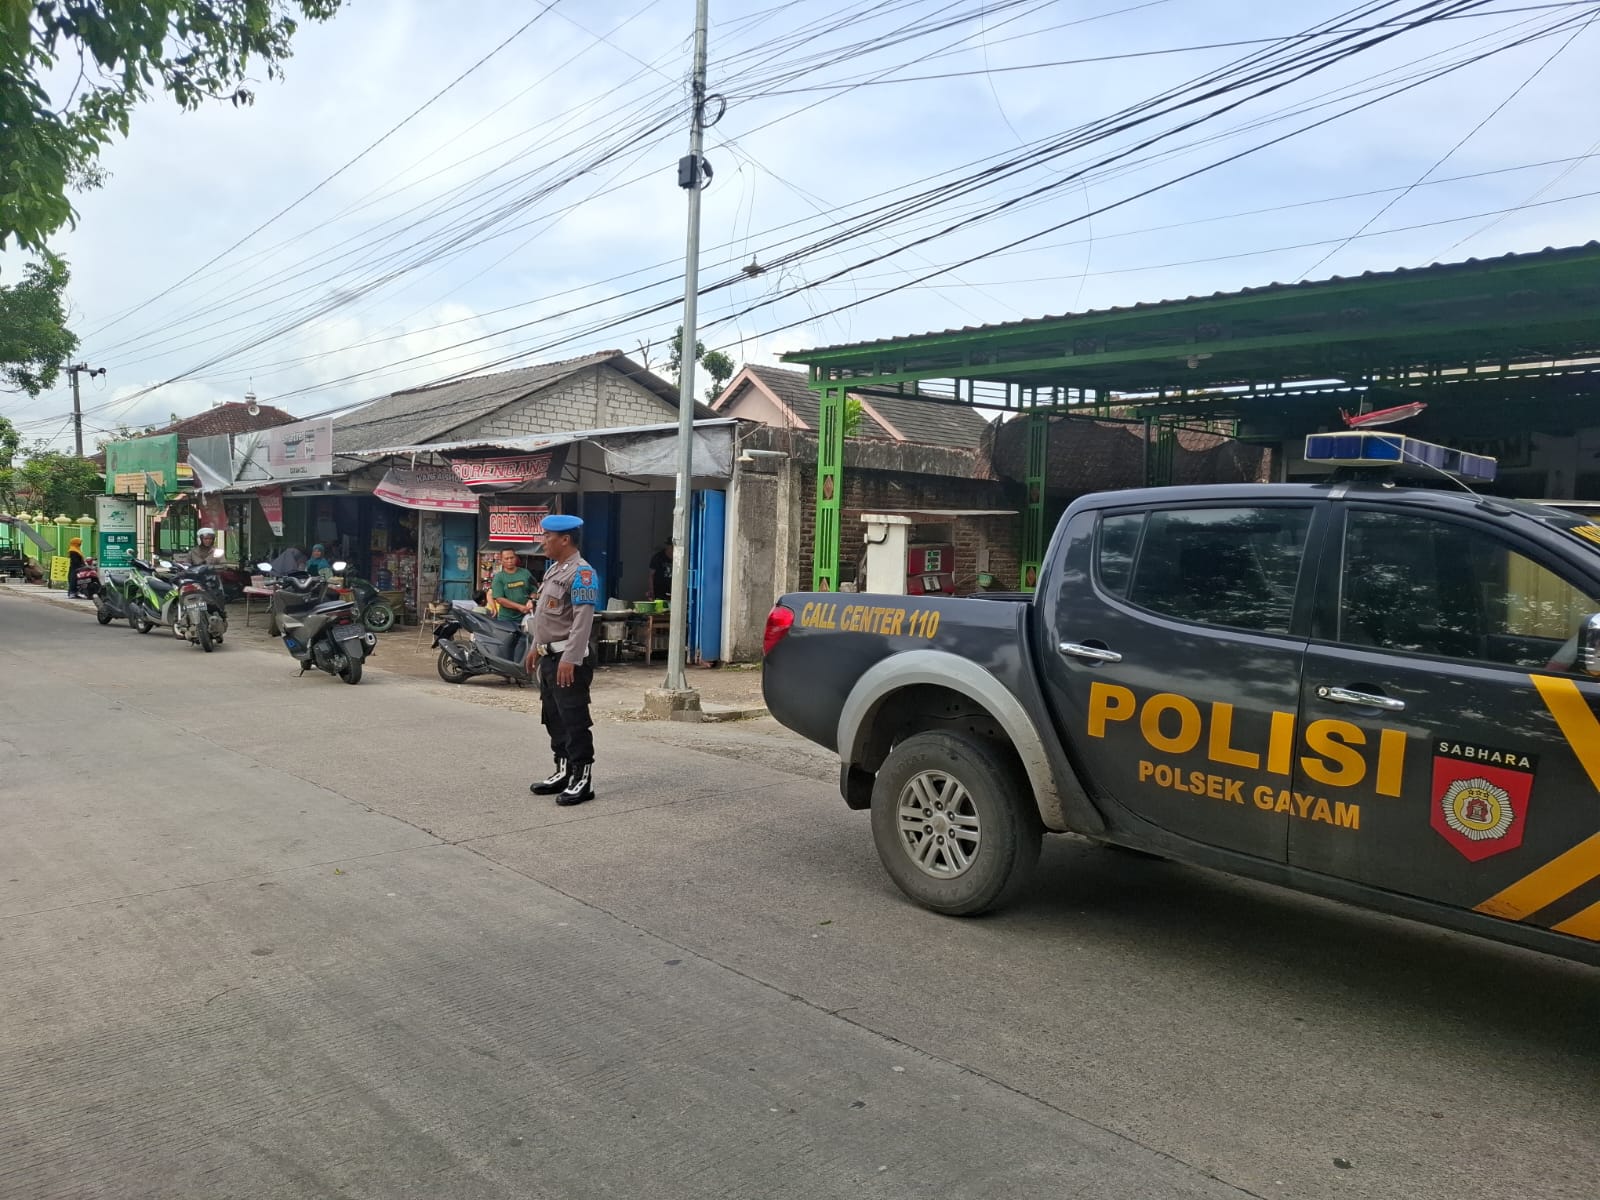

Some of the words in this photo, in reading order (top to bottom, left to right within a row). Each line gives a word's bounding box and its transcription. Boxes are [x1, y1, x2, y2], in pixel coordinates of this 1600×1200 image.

[801, 602, 836, 630] CALL
[840, 605, 904, 637] CENTER
[908, 609, 941, 640] 110
[1087, 681, 1408, 798] POLISI
[1439, 741, 1531, 769] SABHARA
[1138, 760, 1246, 804] POLSEK
[1253, 785, 1361, 831] GAYAM
